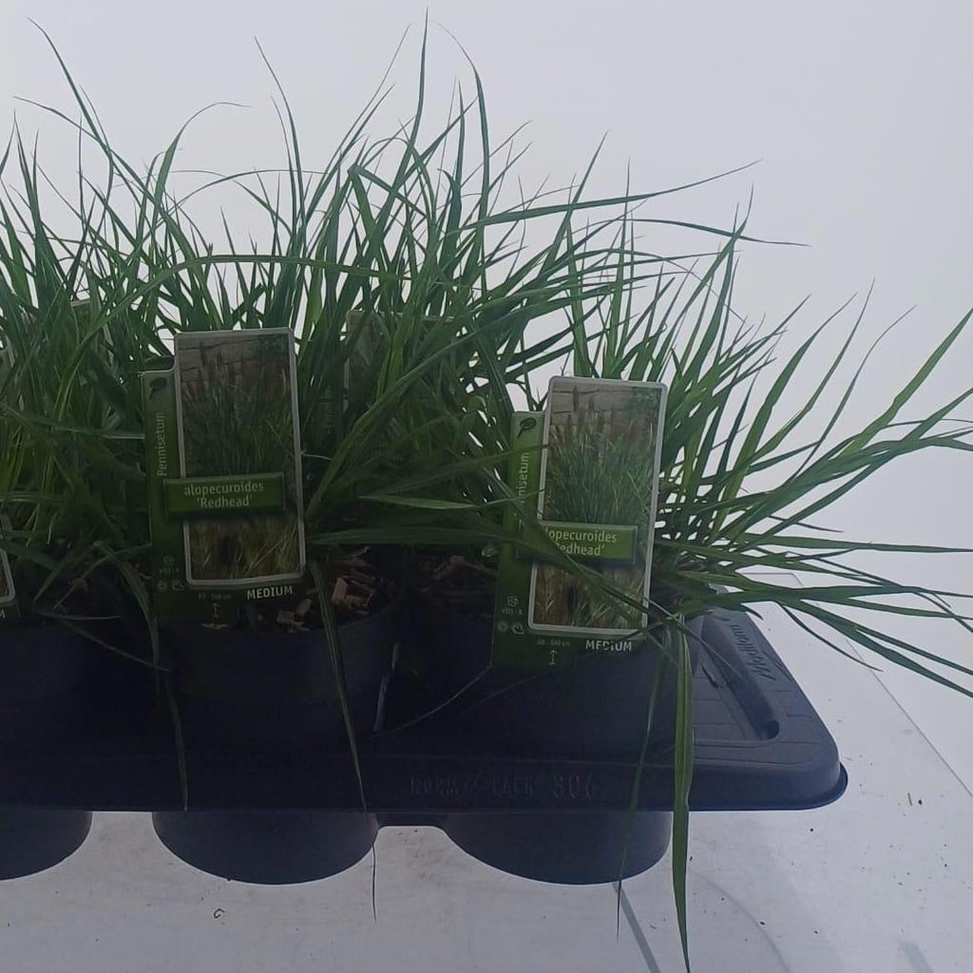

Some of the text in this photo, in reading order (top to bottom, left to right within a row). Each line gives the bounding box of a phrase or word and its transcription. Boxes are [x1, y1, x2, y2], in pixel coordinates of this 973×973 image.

[156, 412, 168, 476] Pennisetum
[516, 451, 529, 505] nisetum
[184, 482, 264, 497] alopecuroides
[197, 494, 253, 509] 'Redhead'
[545, 527, 617, 543] opecuroides
[558, 542, 605, 556] edhead'
[246, 585, 293, 601] MEDIUM
[585, 639, 632, 652] MEDIUM
